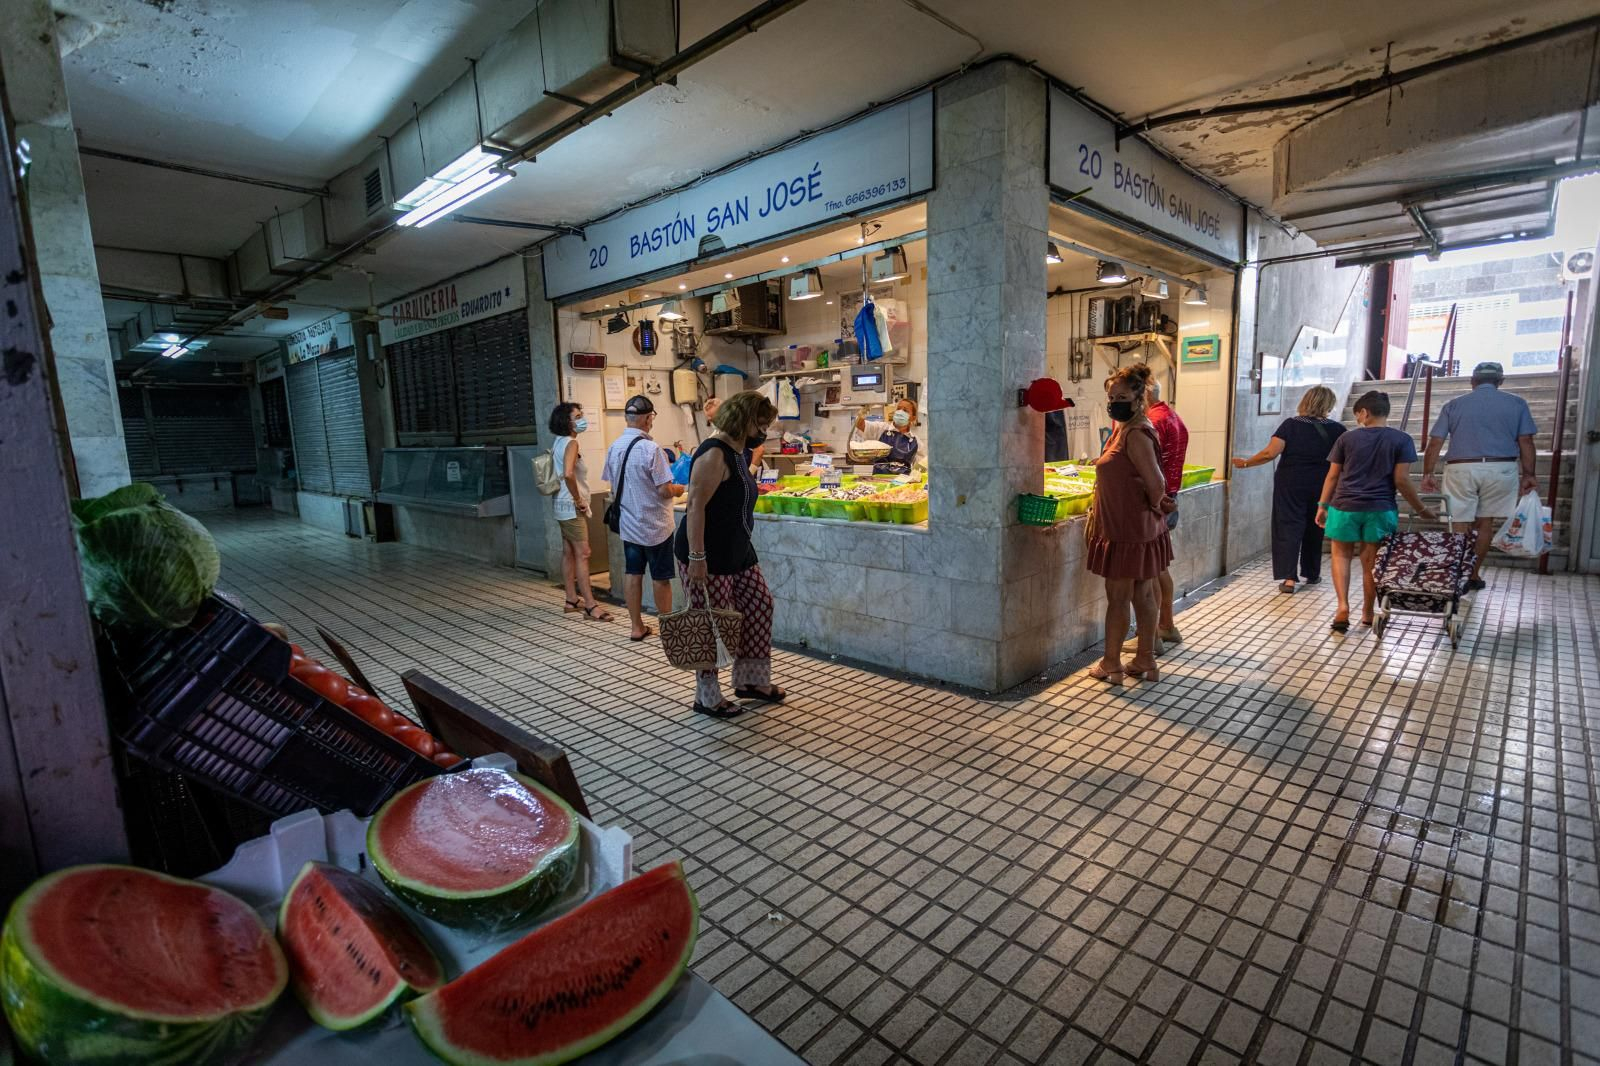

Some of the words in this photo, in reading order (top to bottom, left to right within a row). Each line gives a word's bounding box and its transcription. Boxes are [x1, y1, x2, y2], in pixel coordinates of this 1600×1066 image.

[589, 245, 609, 270] 20
[630, 211, 695, 259] BASTÓN
[707, 195, 749, 234] SAN
[758, 161, 823, 218] JOSÉ
[845, 177, 907, 206] 666396133
[1079, 143, 1102, 180] 20
[1114, 161, 1165, 213] BASTÓN
[1169, 194, 1192, 228] SAN
[1195, 208, 1221, 241] JOSÉ
[461, 289, 502, 319] EDUARDITO
